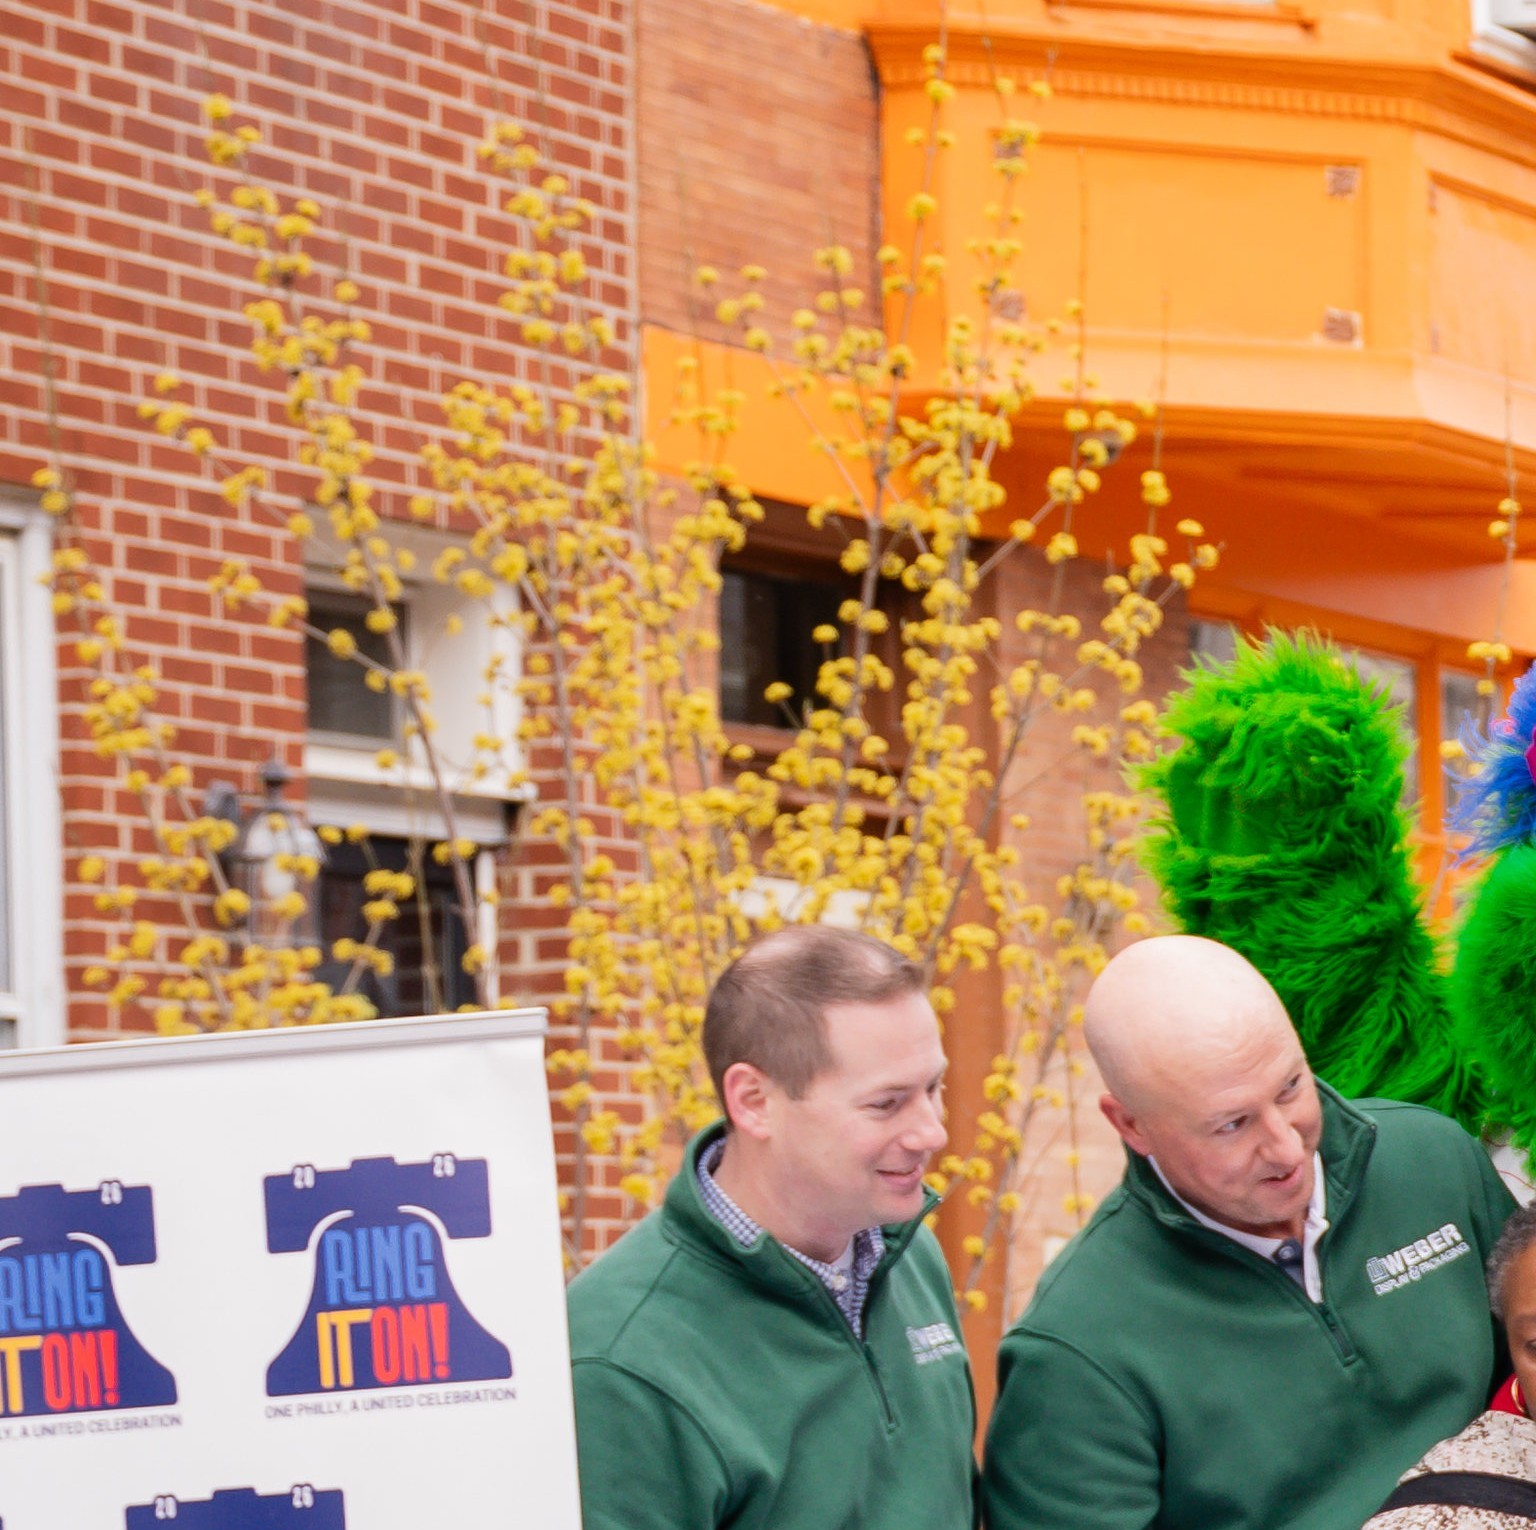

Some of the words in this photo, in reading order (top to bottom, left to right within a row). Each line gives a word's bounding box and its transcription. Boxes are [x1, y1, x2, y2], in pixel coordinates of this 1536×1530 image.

[323, 1222, 437, 1306] RING
[1383, 1223, 1463, 1276] WEBER
[42, 1329, 120, 1411] ON!
[316, 1308, 372, 1389] IT
[371, 1303, 451, 1384] ON!
